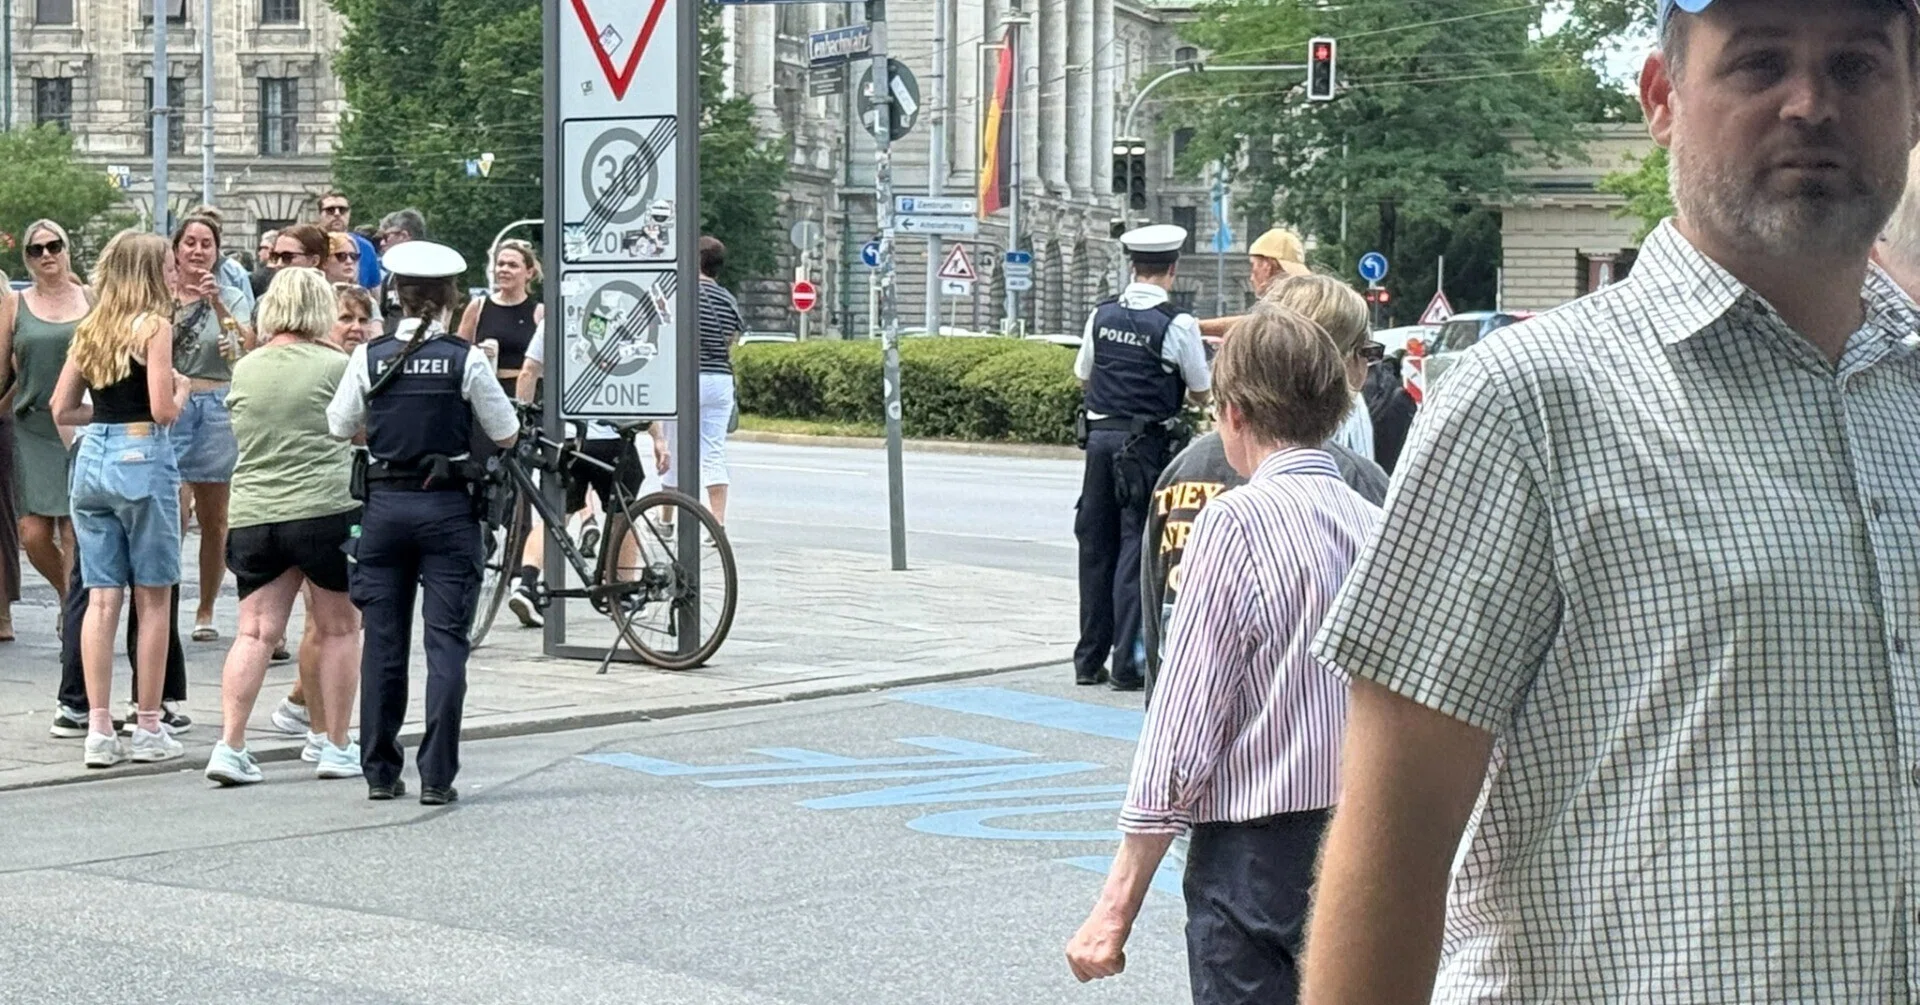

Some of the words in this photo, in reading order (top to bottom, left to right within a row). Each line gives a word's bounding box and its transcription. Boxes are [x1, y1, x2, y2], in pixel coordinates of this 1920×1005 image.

[809, 31, 872, 60] Lenbachplatz
[598, 154, 641, 197] 30
[917, 199, 954, 209] Zentrum
[376, 359, 450, 375] PLIZEI
[591, 383, 650, 406] ZONE
[1155, 481, 1226, 515] THEY
